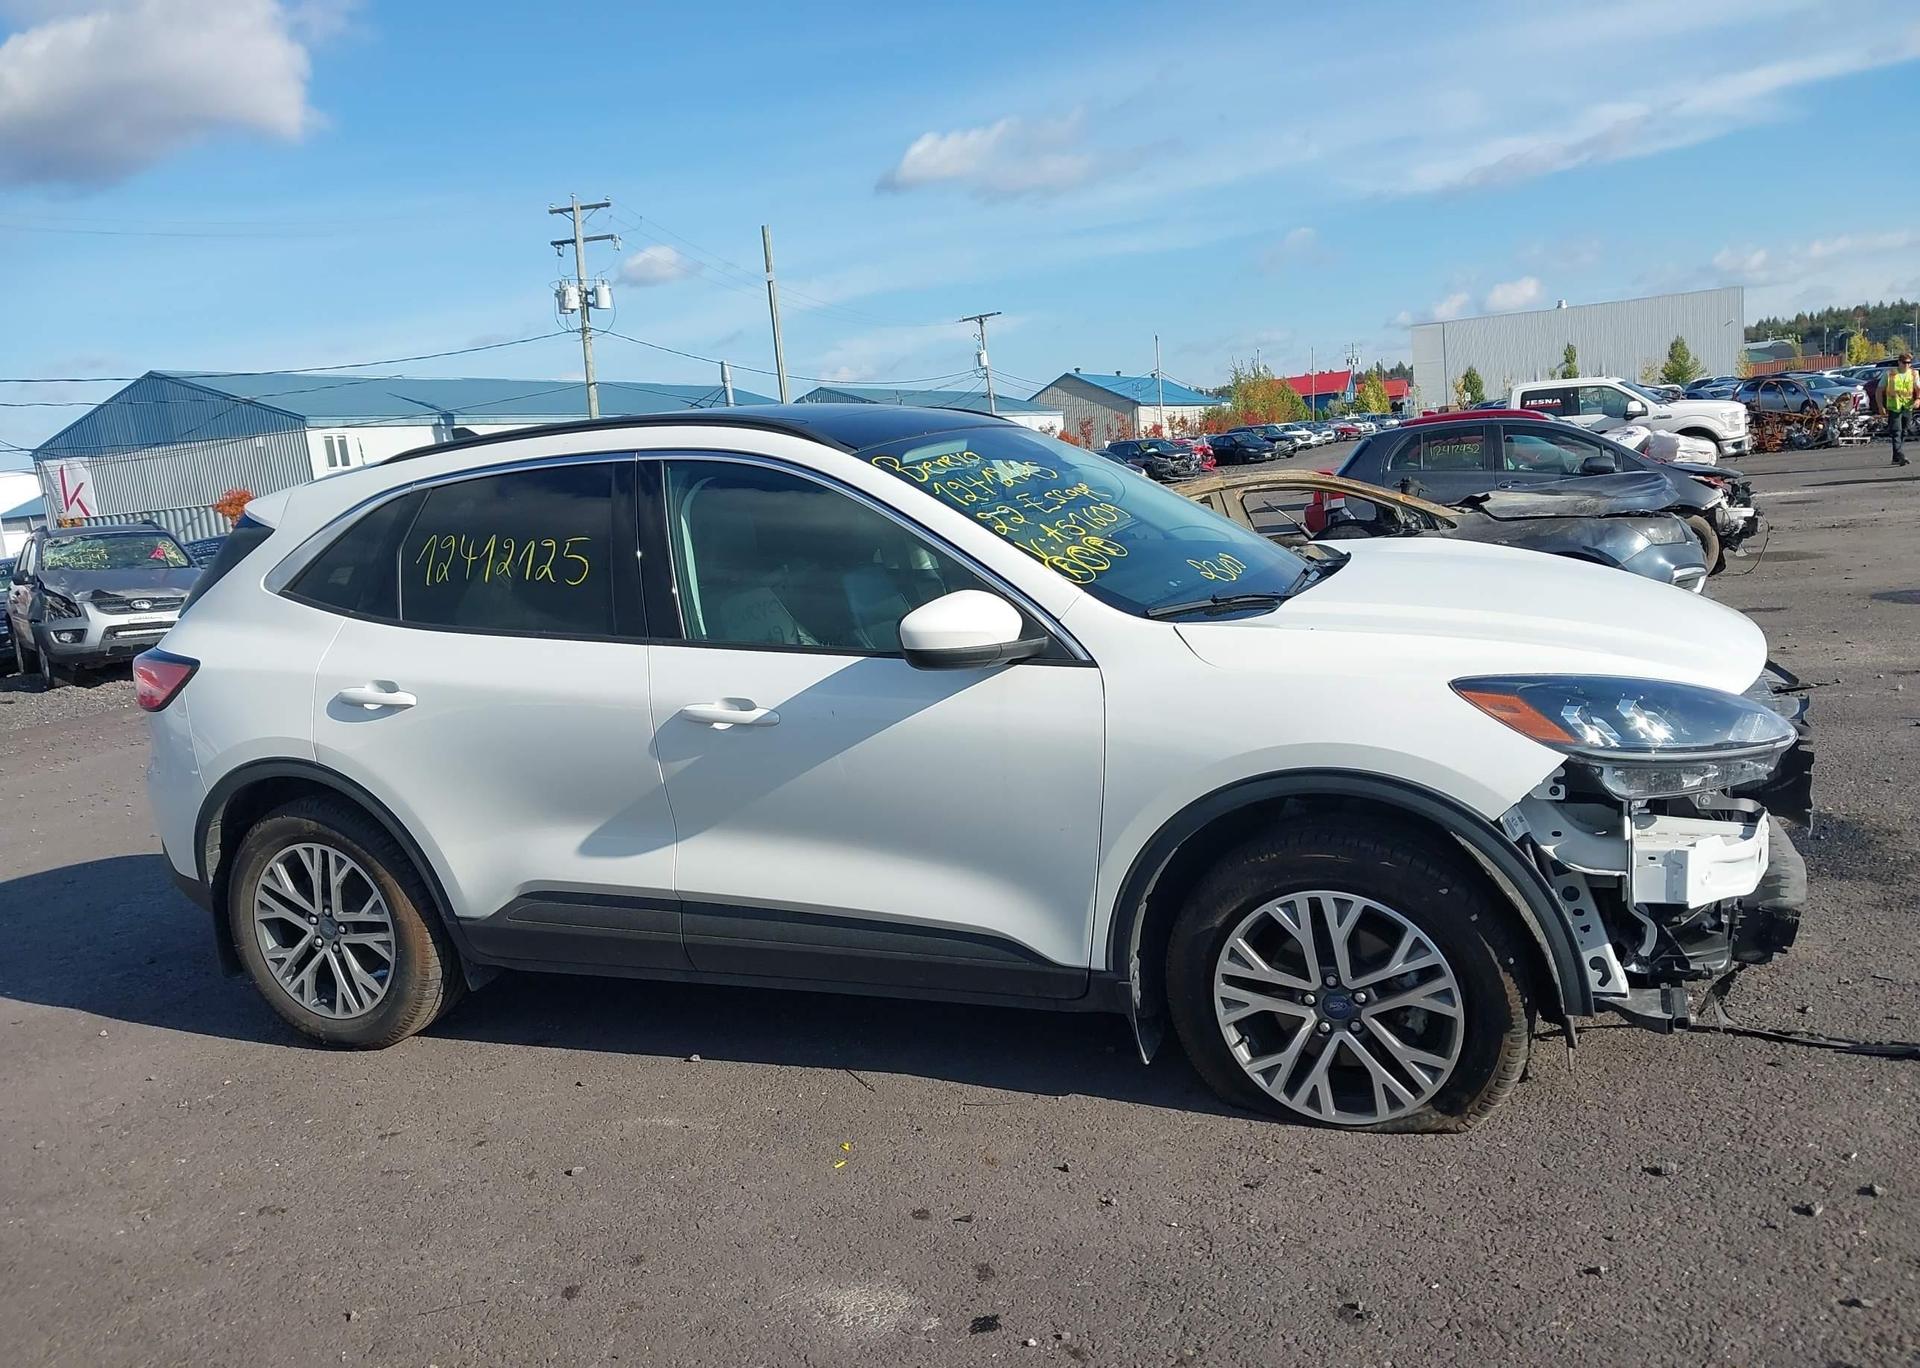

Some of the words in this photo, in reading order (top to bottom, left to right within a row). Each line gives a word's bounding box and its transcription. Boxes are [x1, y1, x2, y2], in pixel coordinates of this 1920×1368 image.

[1525, 398, 1562, 406] JESNA
[976, 505, 1035, 536] 22
[1016, 482, 1113, 514] Escape
[415, 533, 592, 586] 12412125
